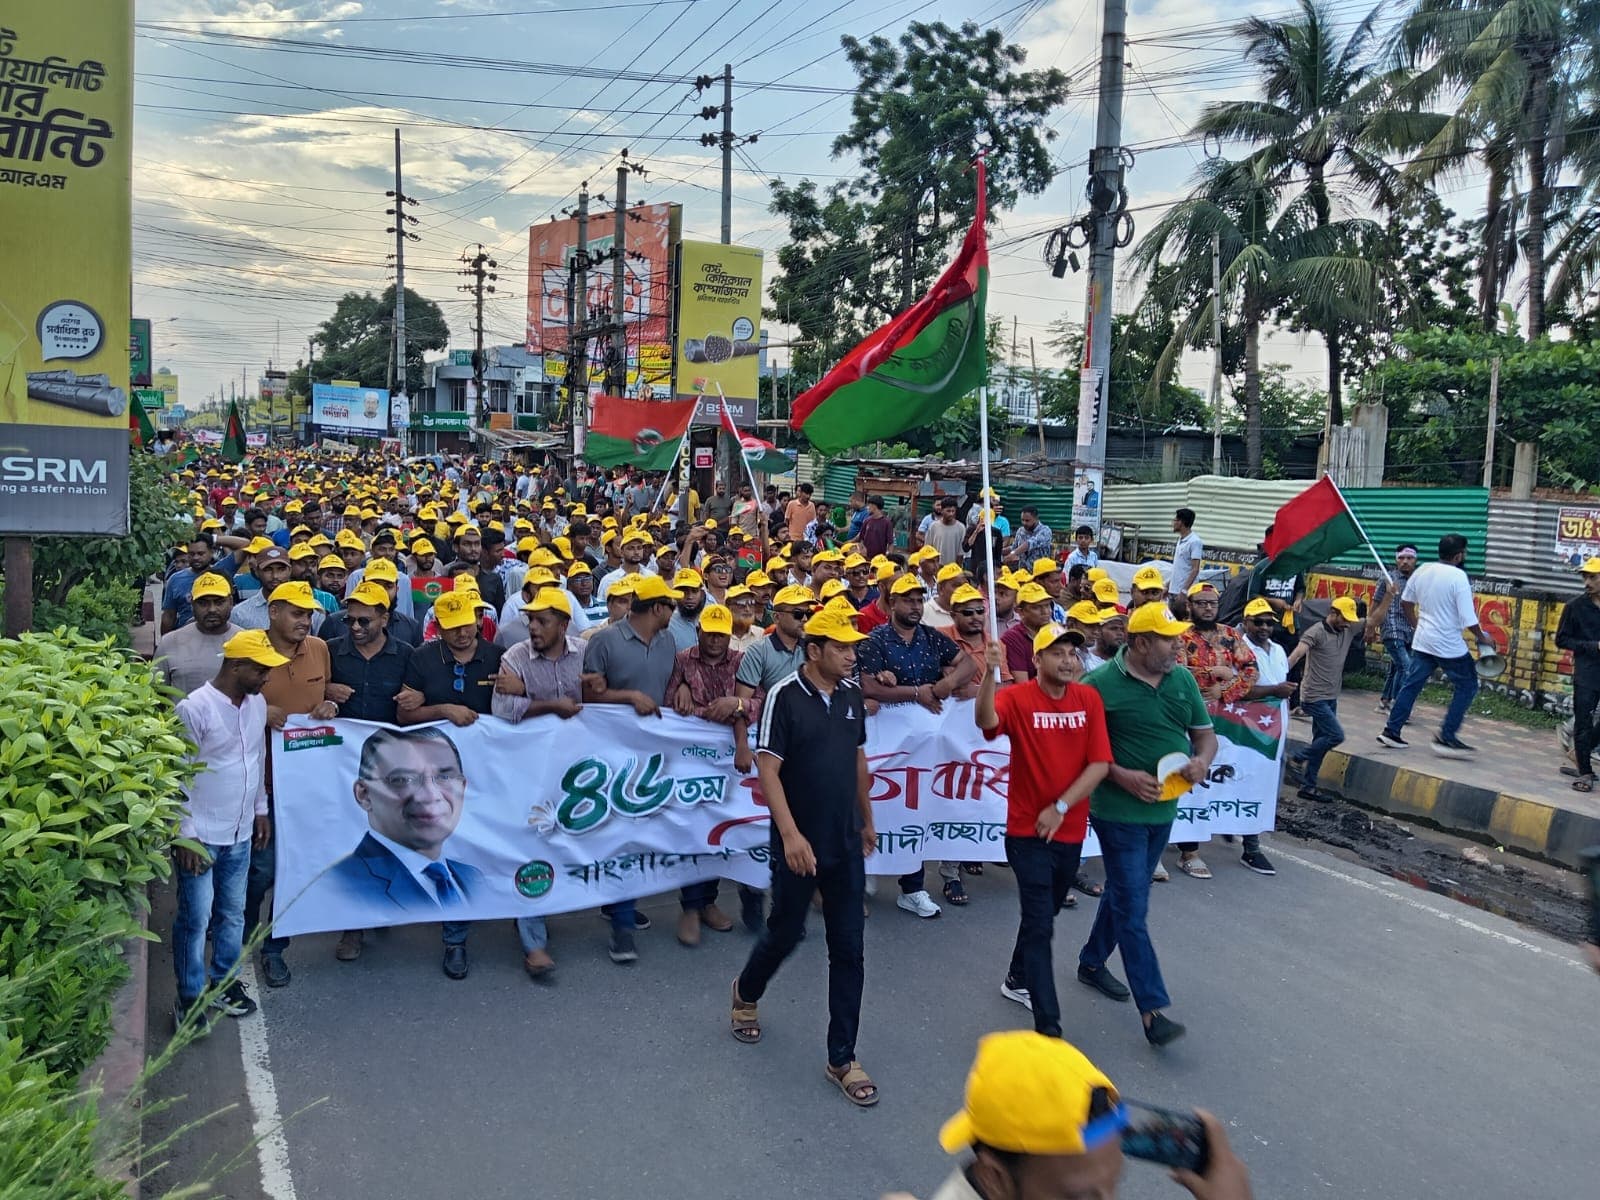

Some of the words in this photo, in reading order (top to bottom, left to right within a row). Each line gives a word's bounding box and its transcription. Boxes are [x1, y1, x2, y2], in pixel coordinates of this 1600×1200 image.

[0, 168, 67, 190] আরএম
[47, 324, 80, 335] সর্বাধিক
[82, 328, 96, 337] রড
[1, 457, 107, 484] SRM
[20, 486, 28, 494] a
[31, 484, 65, 494] safer
[68, 485, 107, 495] nation
[1560, 517, 1593, 538] ডাঃ
